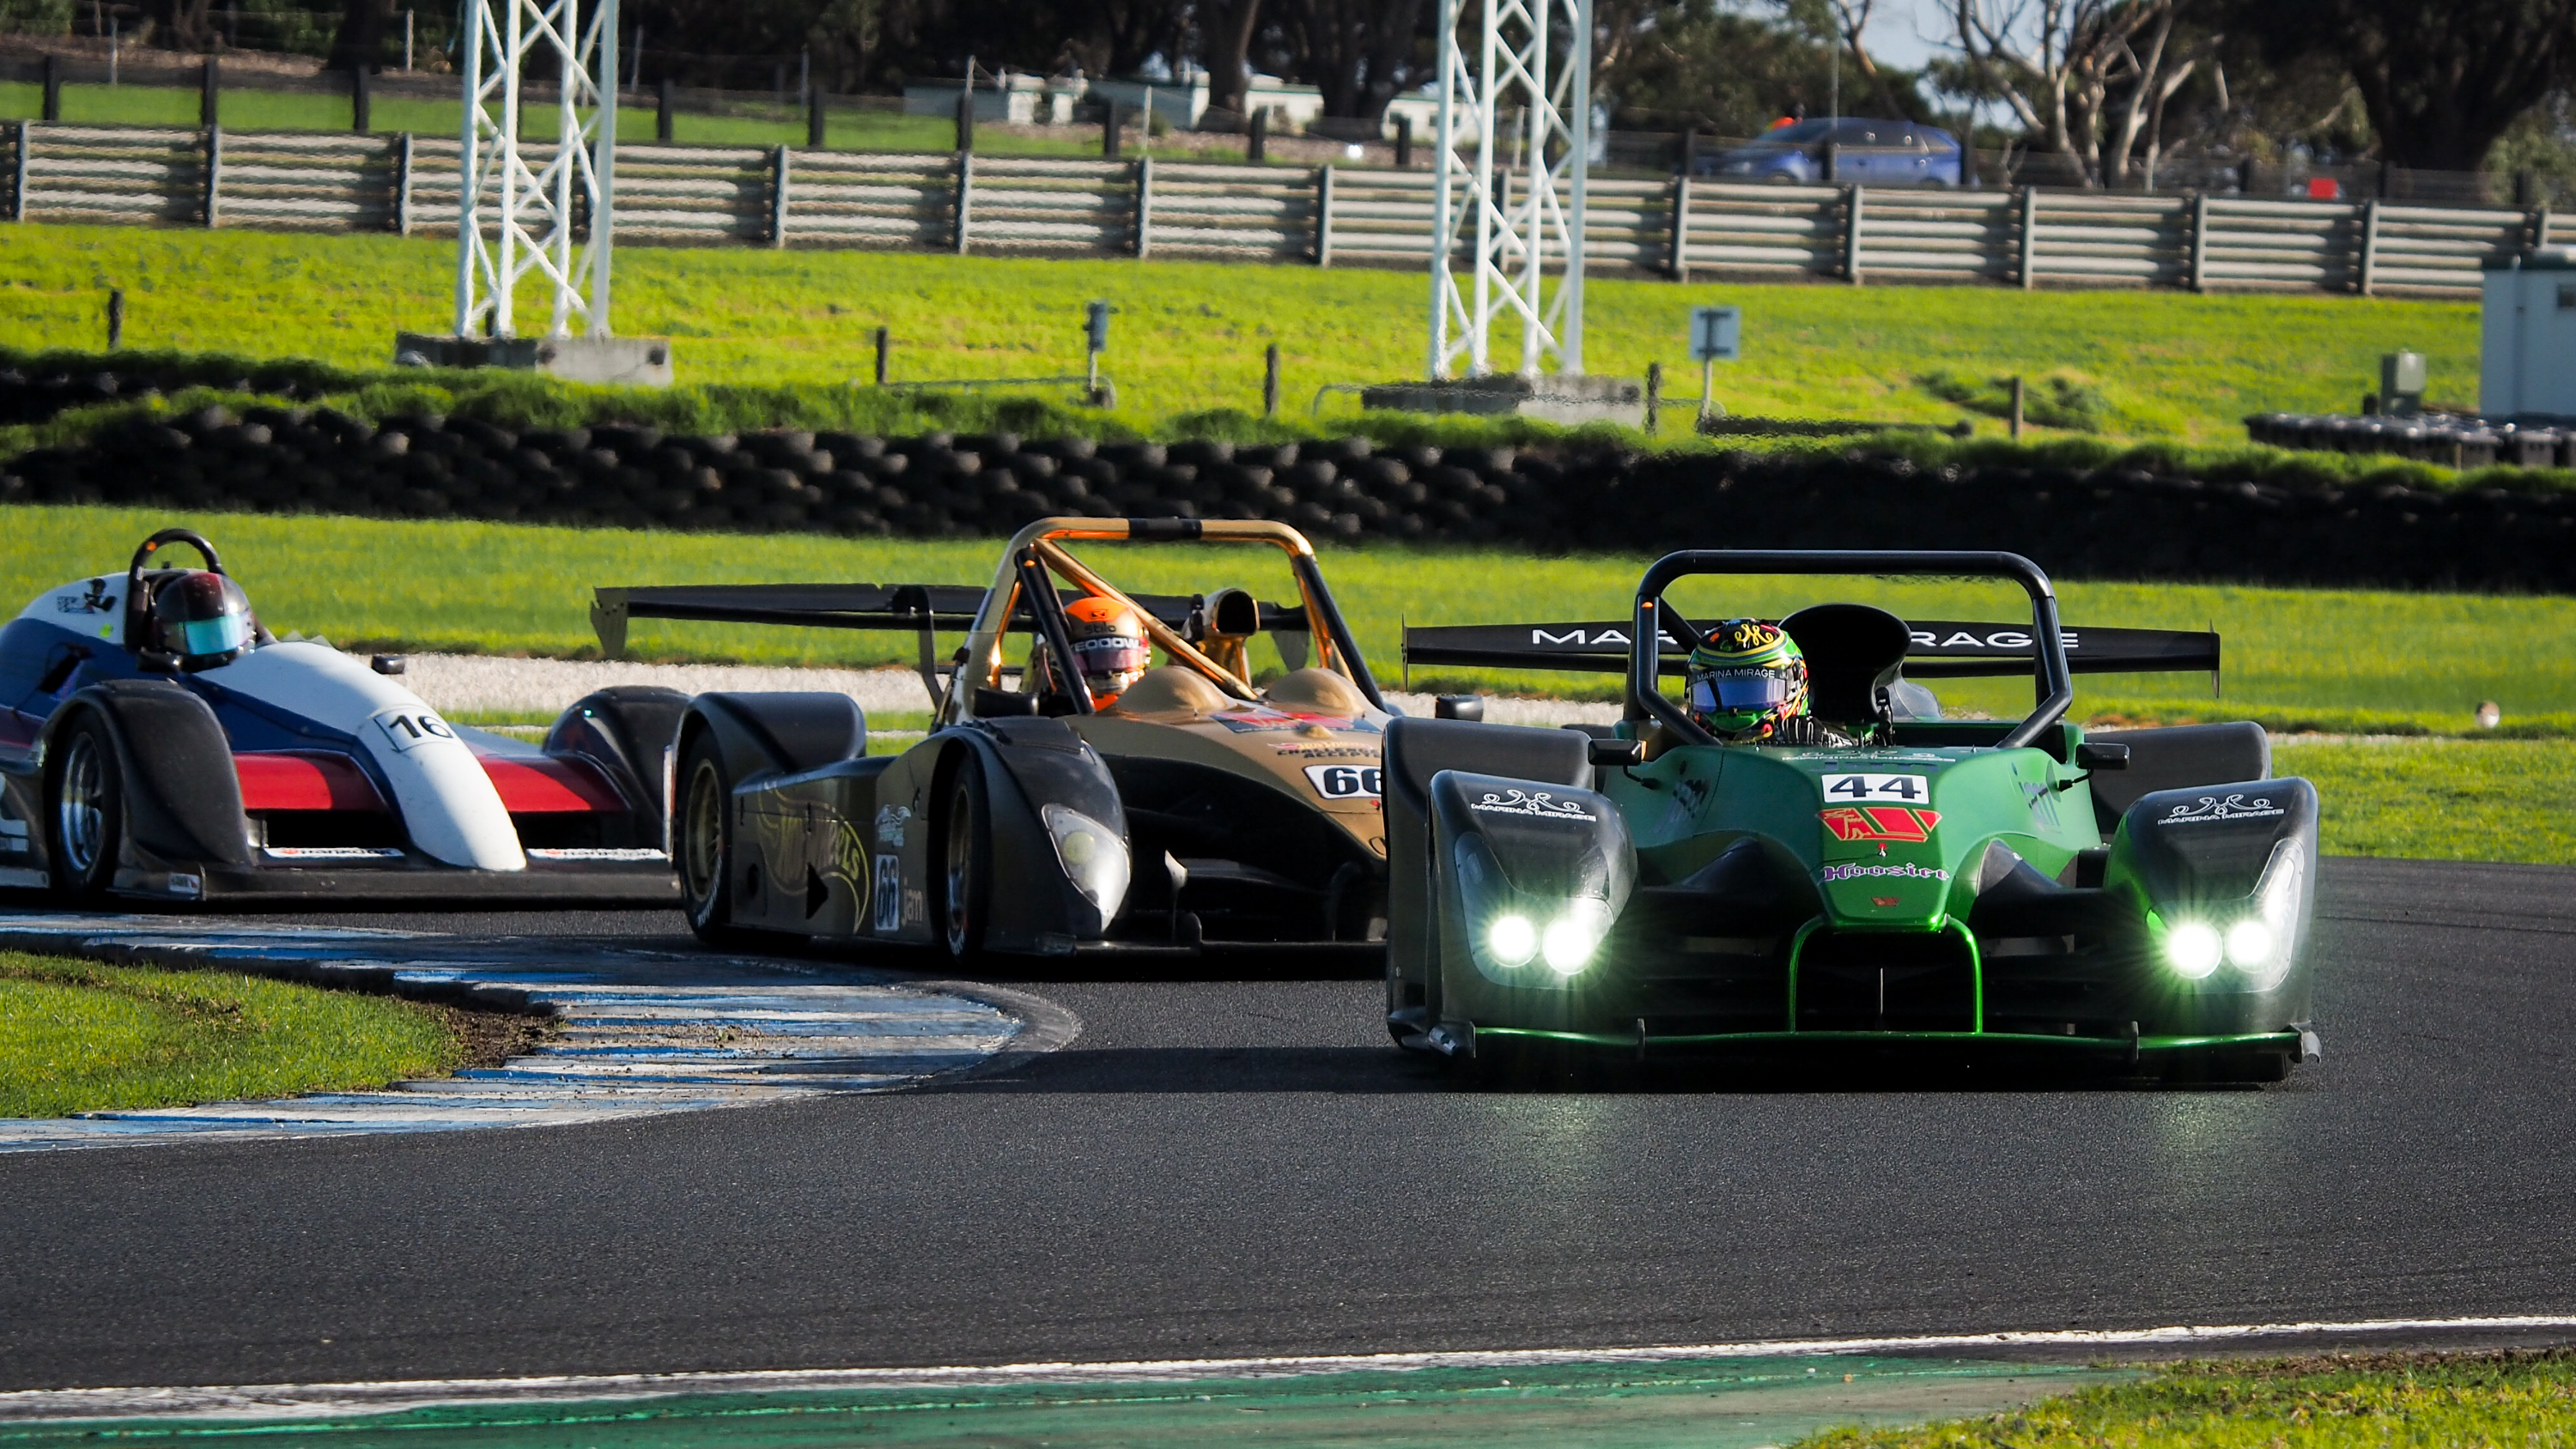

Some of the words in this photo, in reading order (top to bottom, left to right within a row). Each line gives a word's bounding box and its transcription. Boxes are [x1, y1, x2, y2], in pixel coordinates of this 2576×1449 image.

[1697, 669, 1732, 682] MARINA
[1734, 667, 1776, 678] MIRAGE
[389, 714, 453, 739] 16
[1323, 767, 1381, 795] 66
[1830, 776, 1922, 799] 44
[1471, 803, 1534, 815] MARINA
[1535, 810, 1596, 822] MIRAGE
[2158, 815, 2221, 825] MARINA
[2221, 809, 2284, 820] MIRAGE
[1817, 862, 1950, 885] Hoosier
[878, 857, 898, 928] 66
